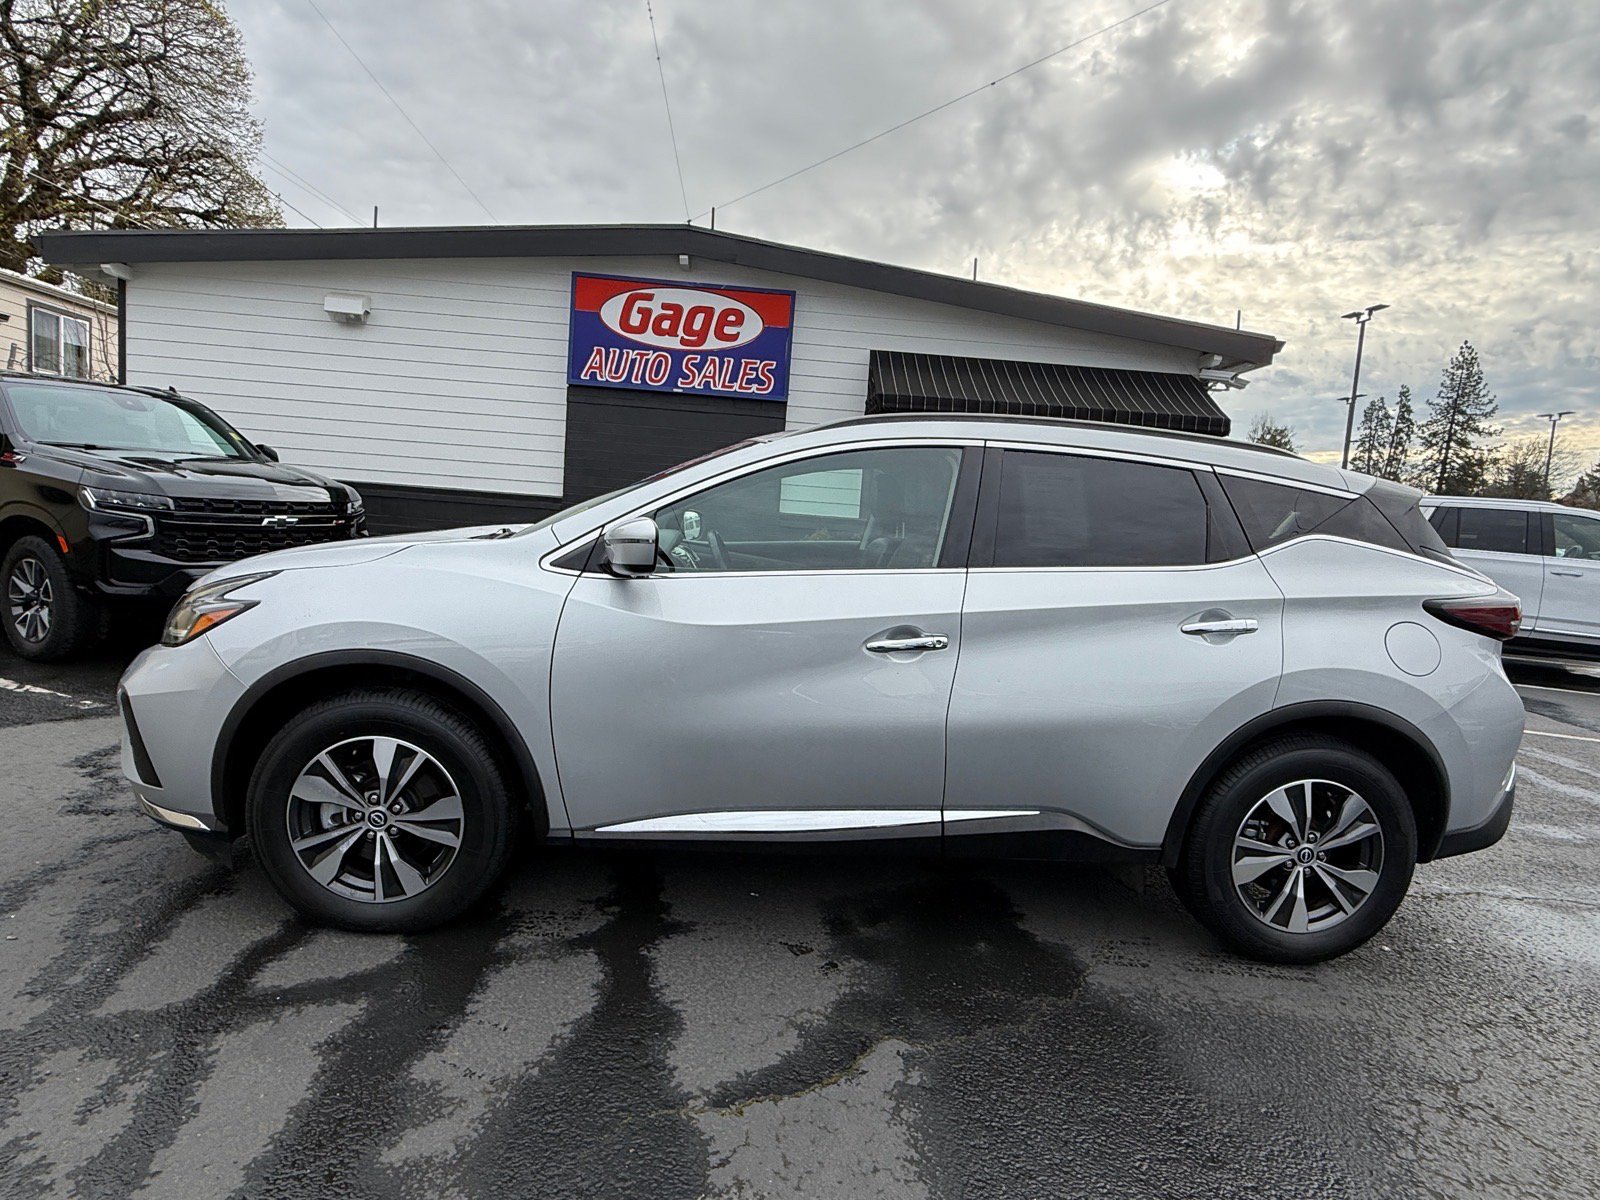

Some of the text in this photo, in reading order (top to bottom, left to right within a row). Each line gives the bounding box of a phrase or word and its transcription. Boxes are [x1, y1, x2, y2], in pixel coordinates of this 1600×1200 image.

[618, 291, 745, 348] Gage
[581, 346, 776, 394] AUTO SALES
